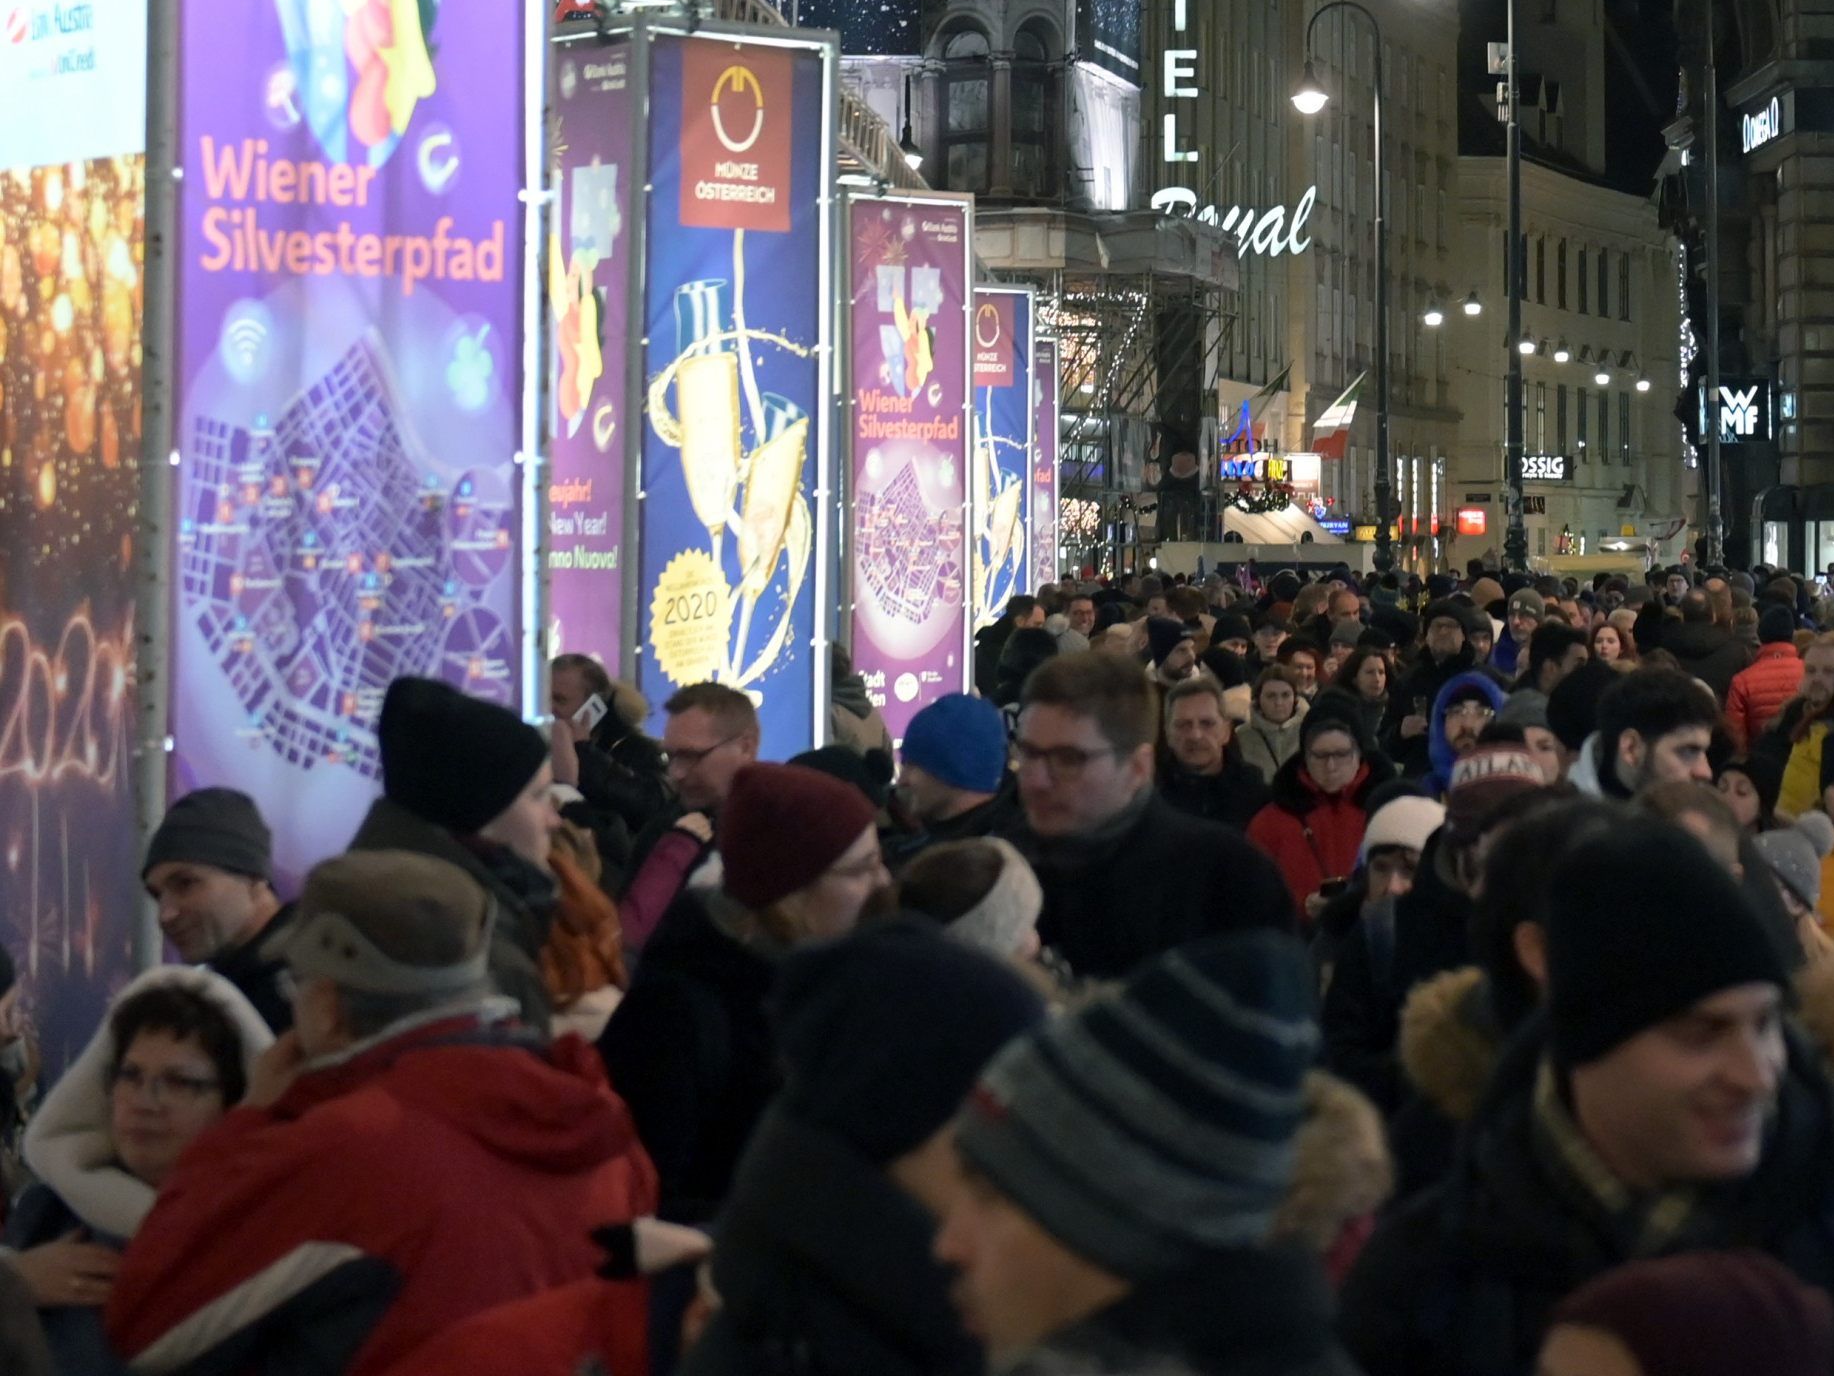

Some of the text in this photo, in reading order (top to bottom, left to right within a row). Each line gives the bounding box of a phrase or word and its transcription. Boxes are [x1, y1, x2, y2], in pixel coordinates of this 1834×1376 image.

[200, 135, 374, 206] Wiener
[715, 160, 759, 180] MÜNZE
[695, 180, 775, 204] ÖSTERREICH
[200, 208, 504, 294] Silvesterpfad
[974, 362, 1006, 373] STERREICH
[859, 388, 913, 413] Wiener
[859, 415, 959, 445] Silvesterpfad
[1521, 456, 1564, 474] OSSIG
[548, 479, 592, 508] eujahr!
[574, 512, 607, 535] Year!
[549, 544, 618, 568] nno Nuovo!
[664, 591, 717, 625] 2020
